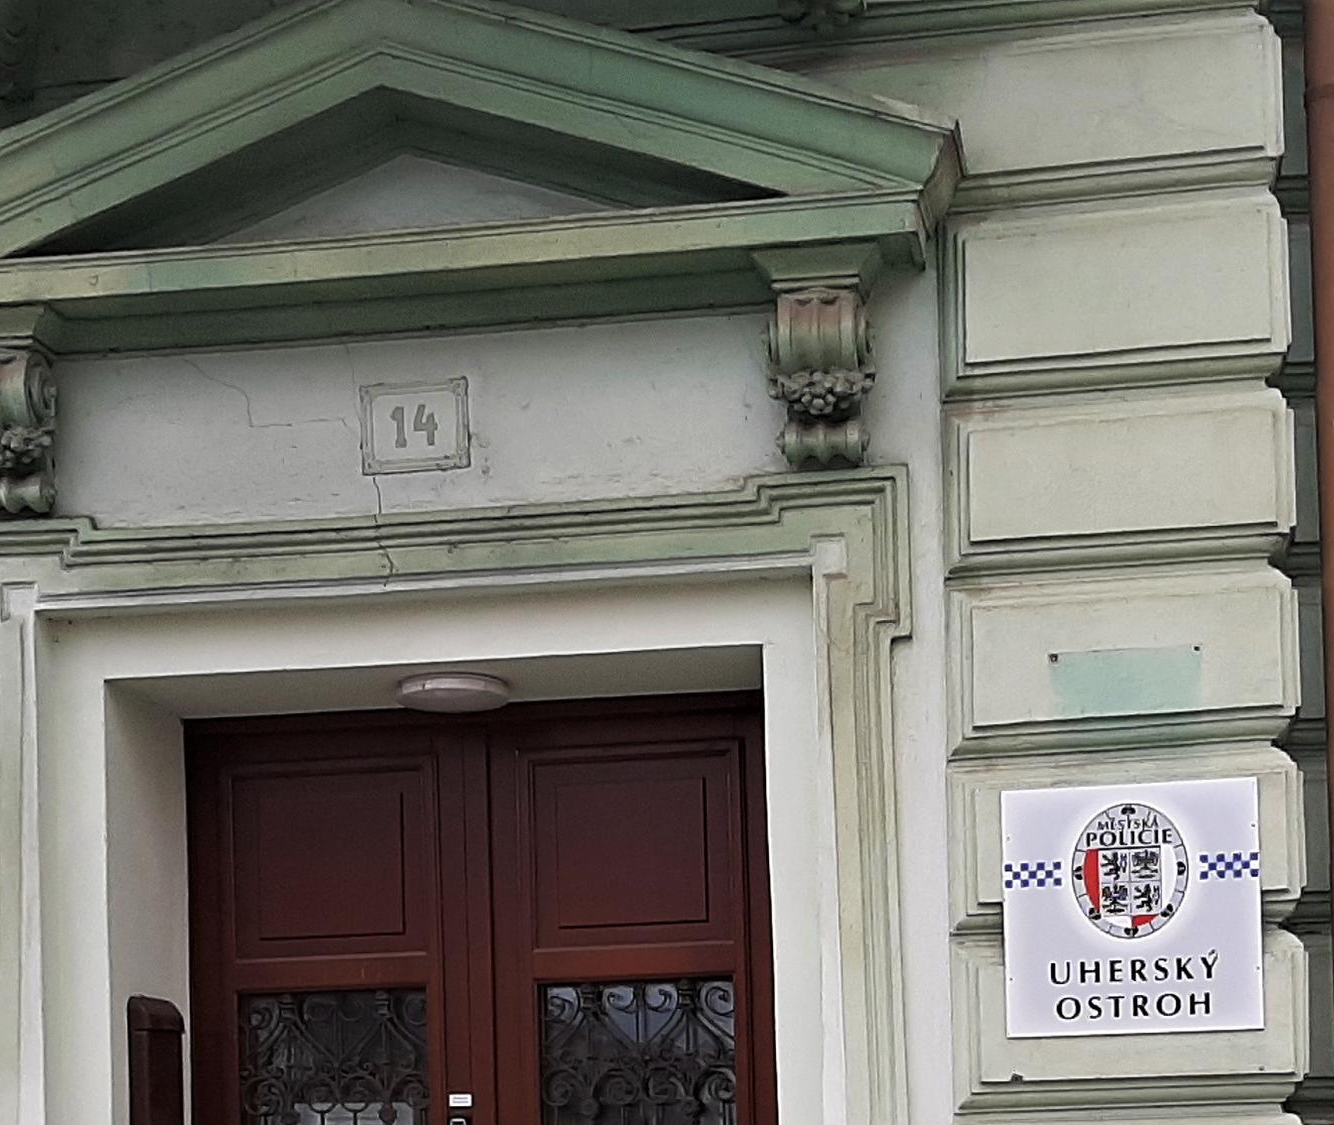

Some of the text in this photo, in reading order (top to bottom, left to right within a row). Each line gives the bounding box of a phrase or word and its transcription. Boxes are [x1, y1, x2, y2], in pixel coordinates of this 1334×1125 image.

[390, 404, 438, 448] 14
[1086, 829, 1174, 846] POLICIE
[1049, 949, 1219, 985] UHERSKÝ
[1056, 992, 1211, 1020] OSTROH
